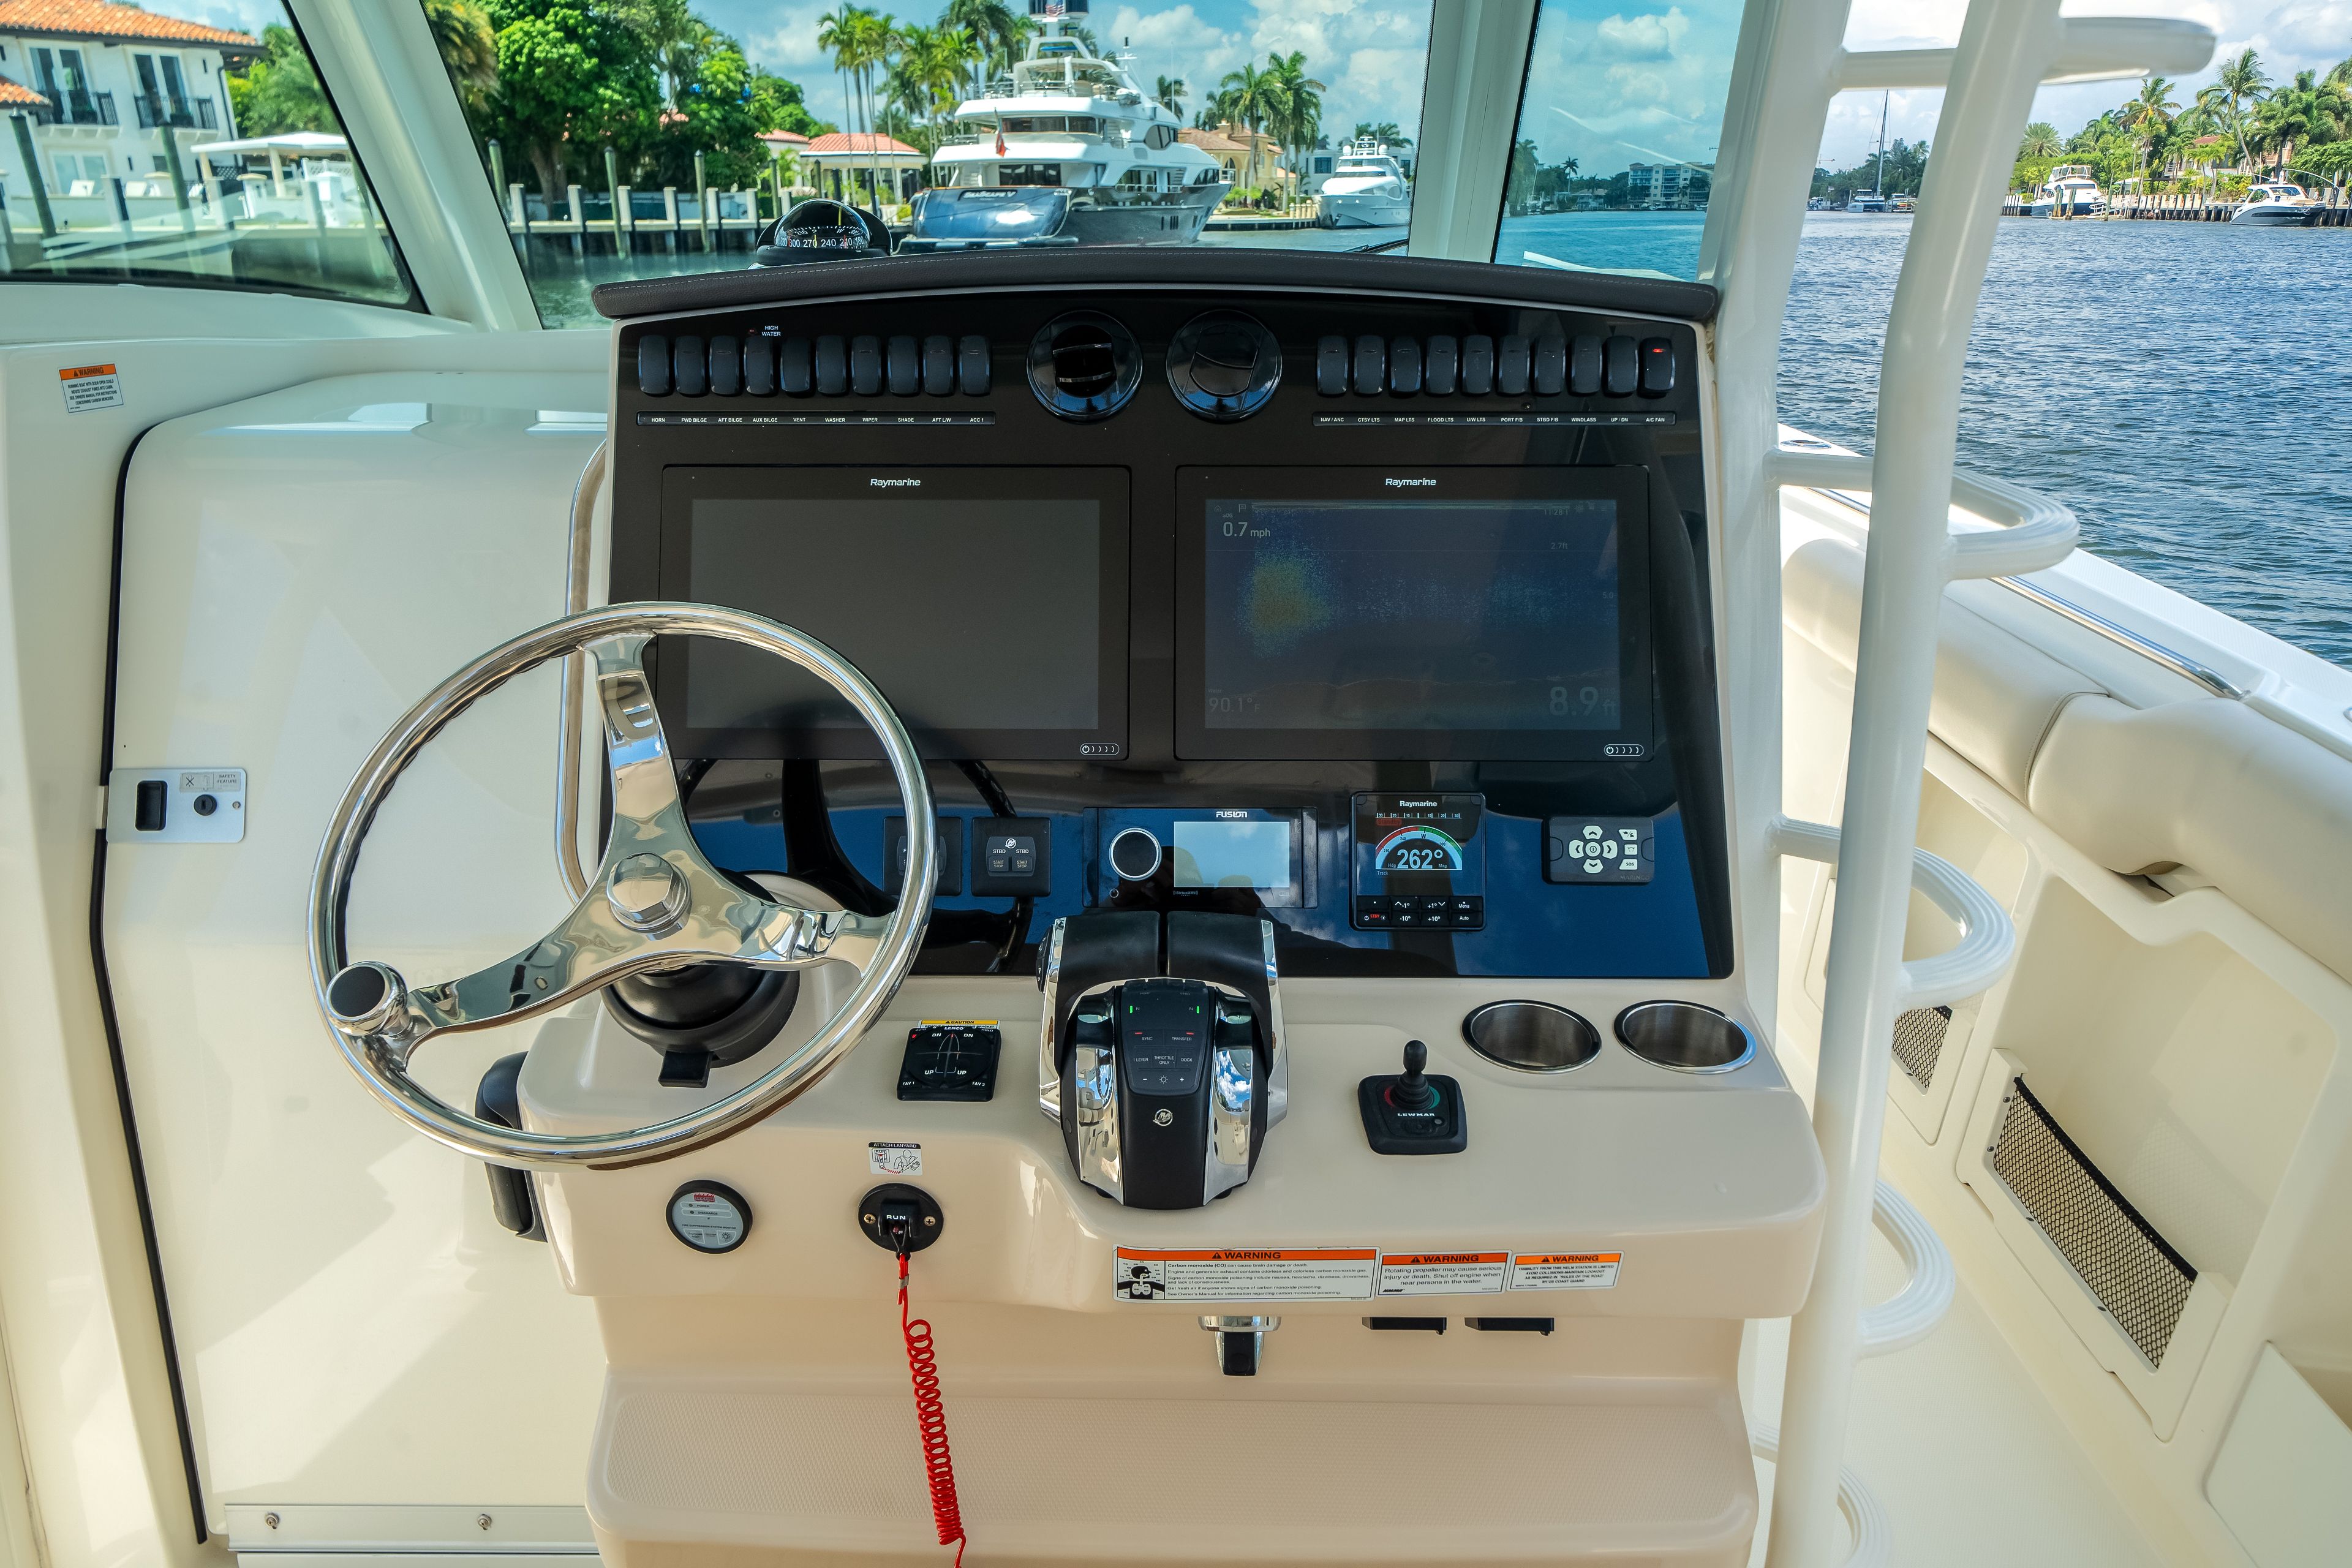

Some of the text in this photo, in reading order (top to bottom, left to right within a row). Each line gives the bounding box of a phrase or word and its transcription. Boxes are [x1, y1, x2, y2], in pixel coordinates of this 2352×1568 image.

[855, 236, 864, 245] 180
[78, 367, 104, 376] WARNING
[870, 478, 921, 488] Raymarine
[1385, 478, 1436, 488] Raymarine
[1223, 522, 1270, 538] 0.7 mph
[1549, 686, 1599, 716] 8.9
[1397, 850, 1443, 869] 262°
